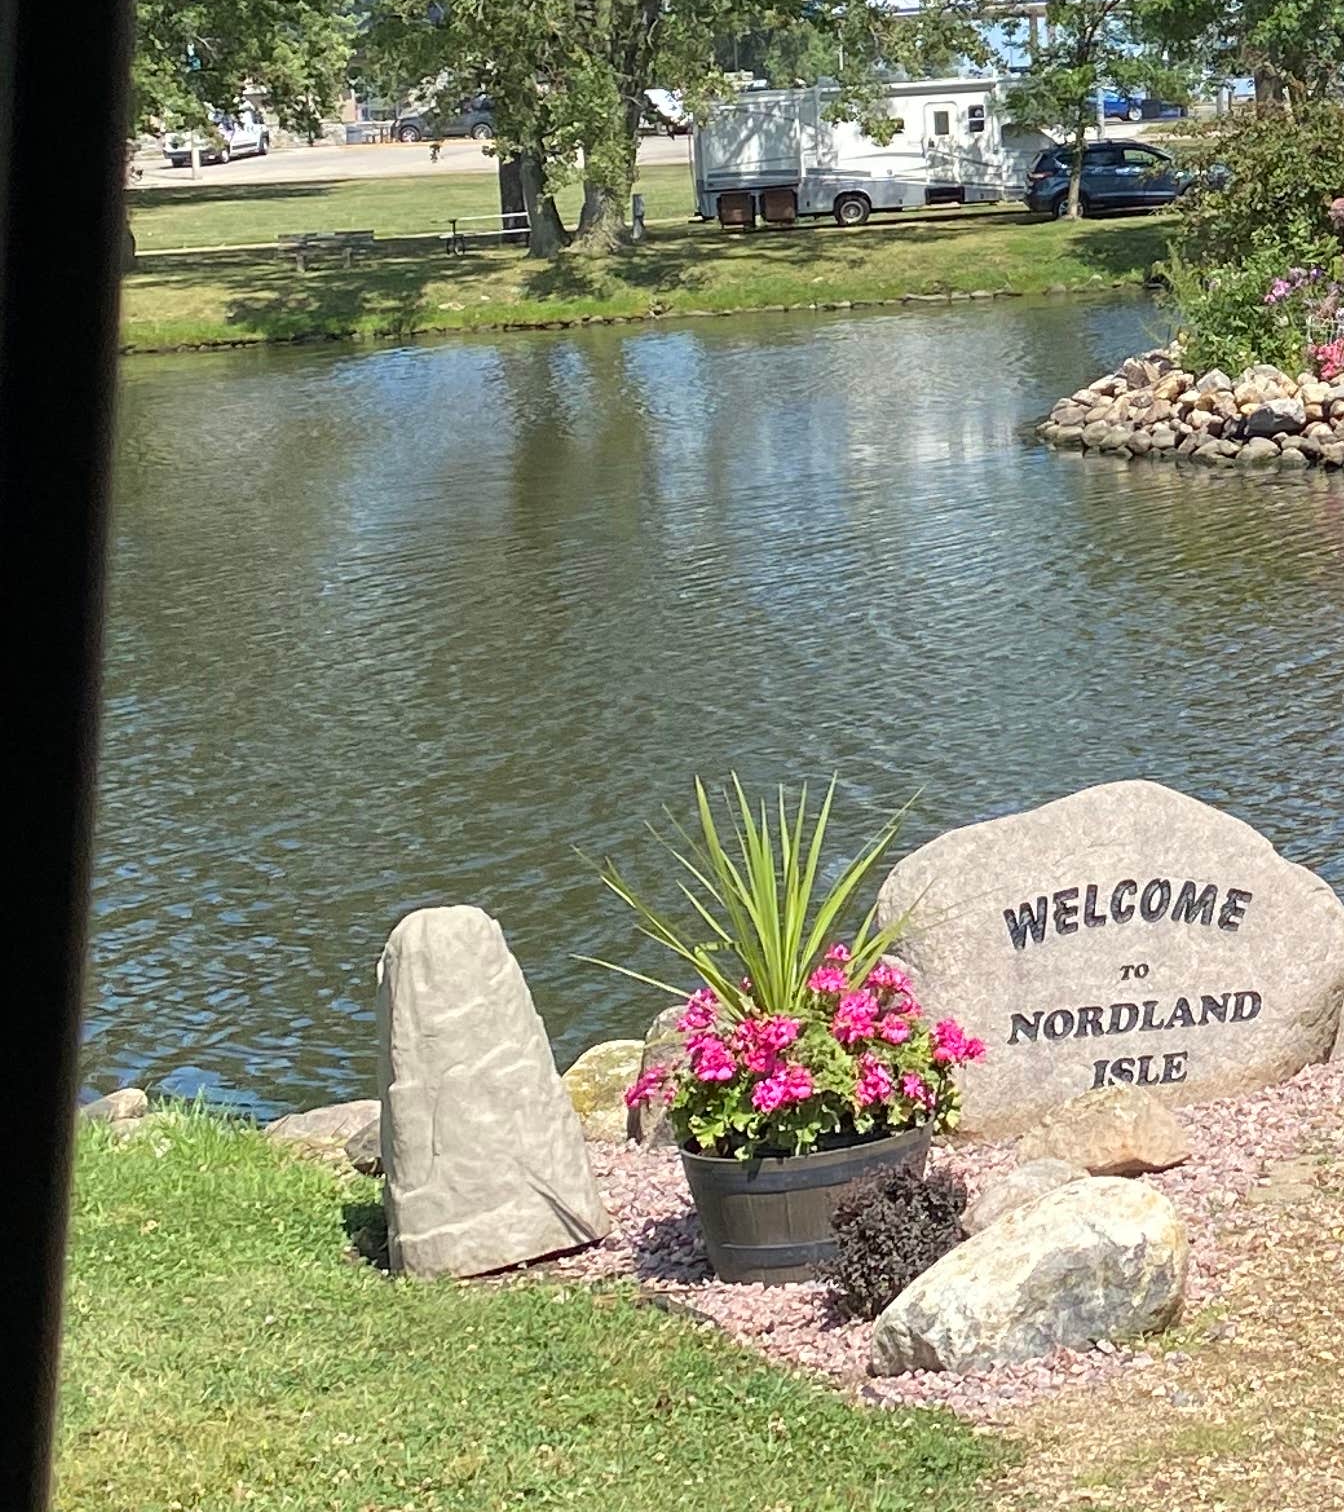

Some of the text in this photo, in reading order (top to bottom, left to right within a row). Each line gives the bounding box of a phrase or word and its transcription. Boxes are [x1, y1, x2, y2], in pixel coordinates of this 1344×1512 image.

[1002, 877, 1254, 951] WELCOME
[1120, 963, 1150, 981] TO
[1006, 990, 1263, 1045] NORDLAND
[1090, 1051, 1190, 1090] ISLE
